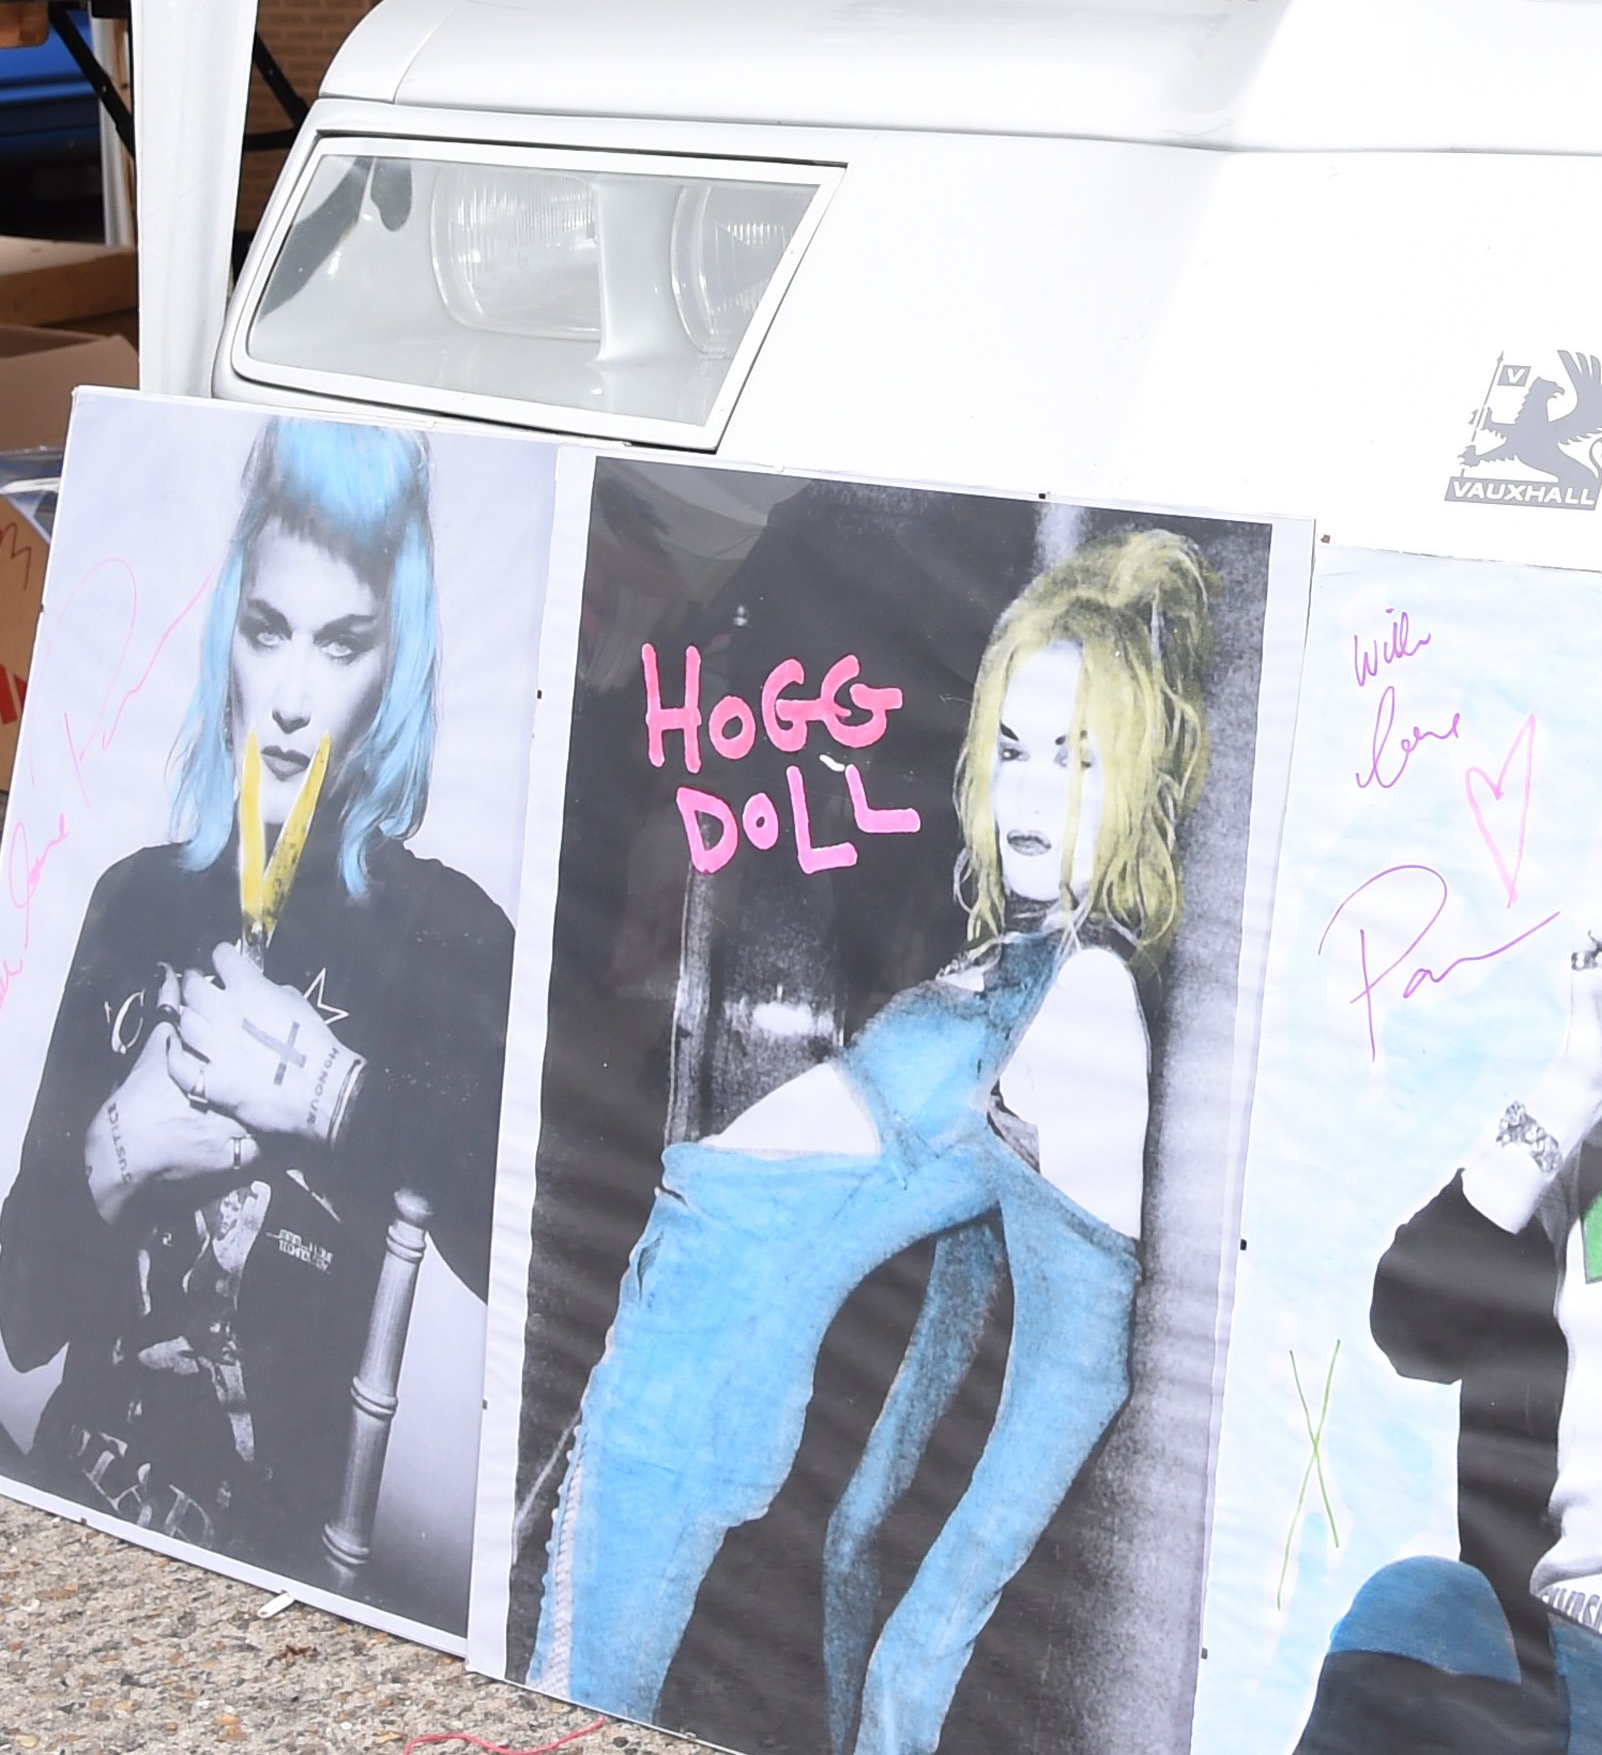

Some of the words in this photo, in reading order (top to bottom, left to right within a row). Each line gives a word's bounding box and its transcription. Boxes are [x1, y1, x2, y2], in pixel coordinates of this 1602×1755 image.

[1452, 480, 1596, 506] VAUXHALL
[641, 642, 904, 775] HOGG
[675, 763, 922, 875] DOLL
